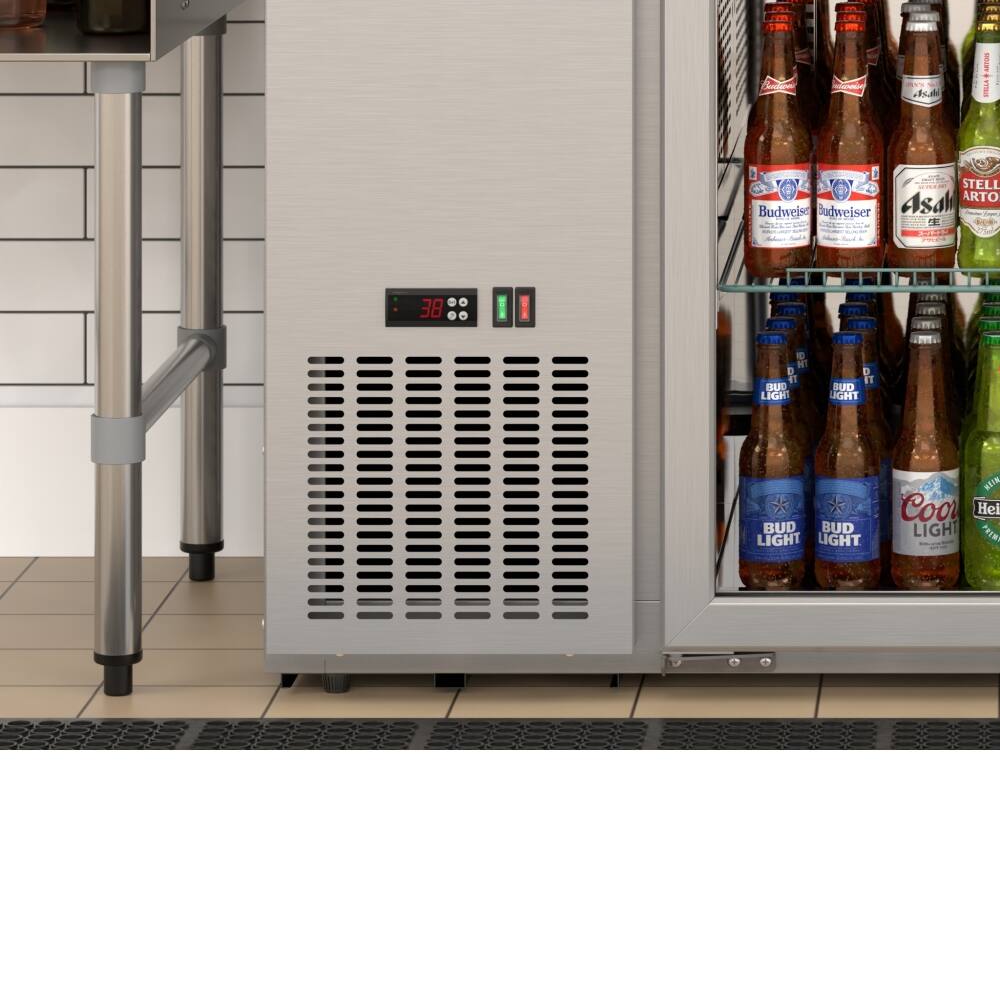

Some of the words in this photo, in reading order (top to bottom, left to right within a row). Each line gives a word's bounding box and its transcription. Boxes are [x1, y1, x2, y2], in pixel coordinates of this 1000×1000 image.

[912, 86, 940, 98] Asahi
[901, 189, 953, 215] Asah
[818, 203, 872, 218] Budweiser
[420, 298, 444, 318] 38
[765, 382, 787, 391] BUD
[833, 382, 855, 391] BUD
[761, 390, 790, 400] LIGHT
[830, 391, 860, 400] LIGHT
[901, 492, 958, 522] Coor
[763, 521, 796, 534] BUD
[821, 521, 855, 534] BUD
[913, 521, 958, 537] LIGHT
[757, 532, 801, 547] LIGHT
[818, 533, 861, 547] LIGHT
